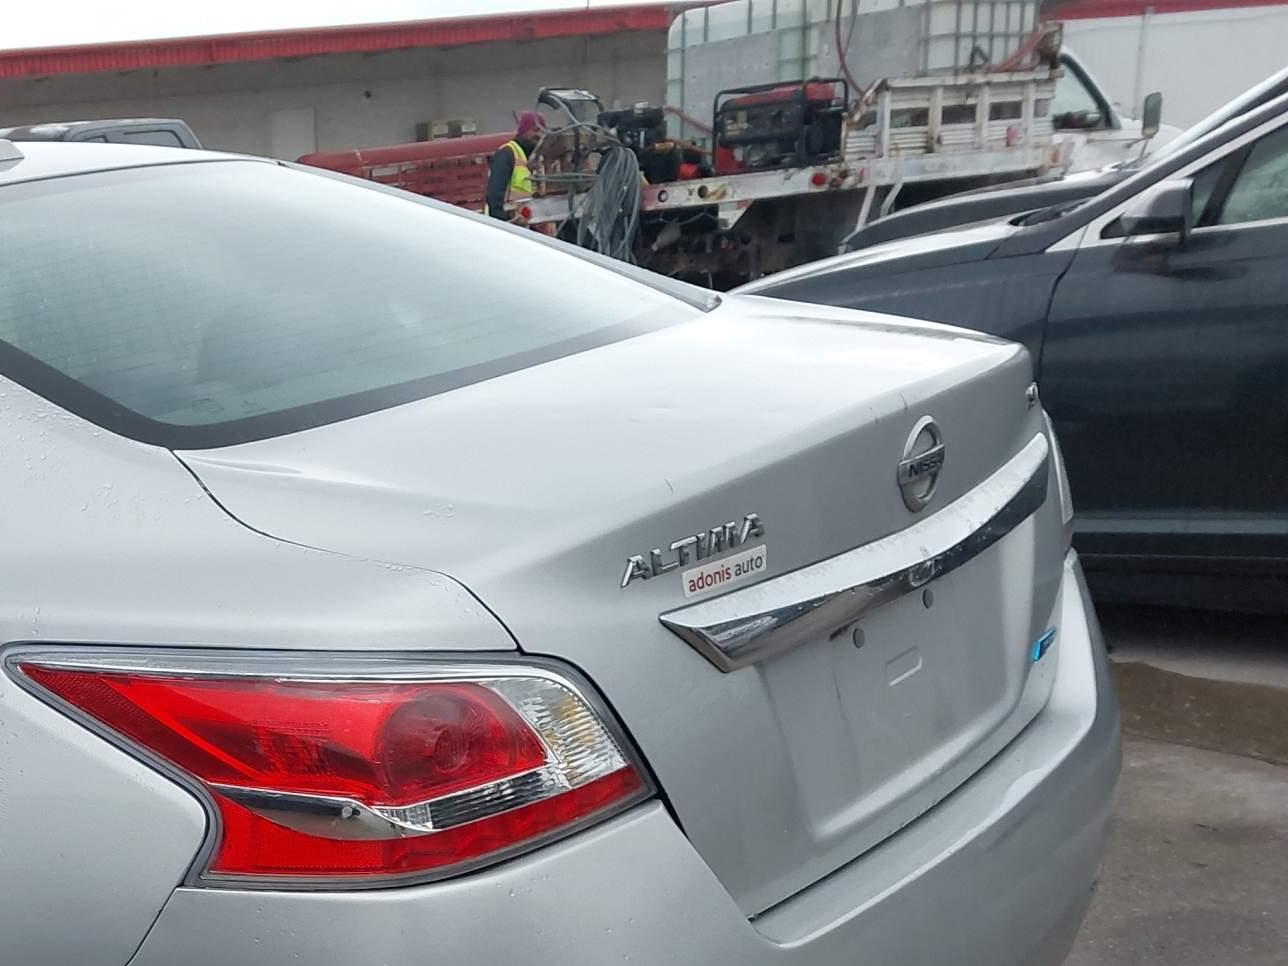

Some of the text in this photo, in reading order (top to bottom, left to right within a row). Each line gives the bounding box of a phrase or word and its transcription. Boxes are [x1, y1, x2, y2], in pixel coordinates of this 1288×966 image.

[621, 512, 765, 589] ALTIMA
[688, 555, 763, 593] adonis auto
